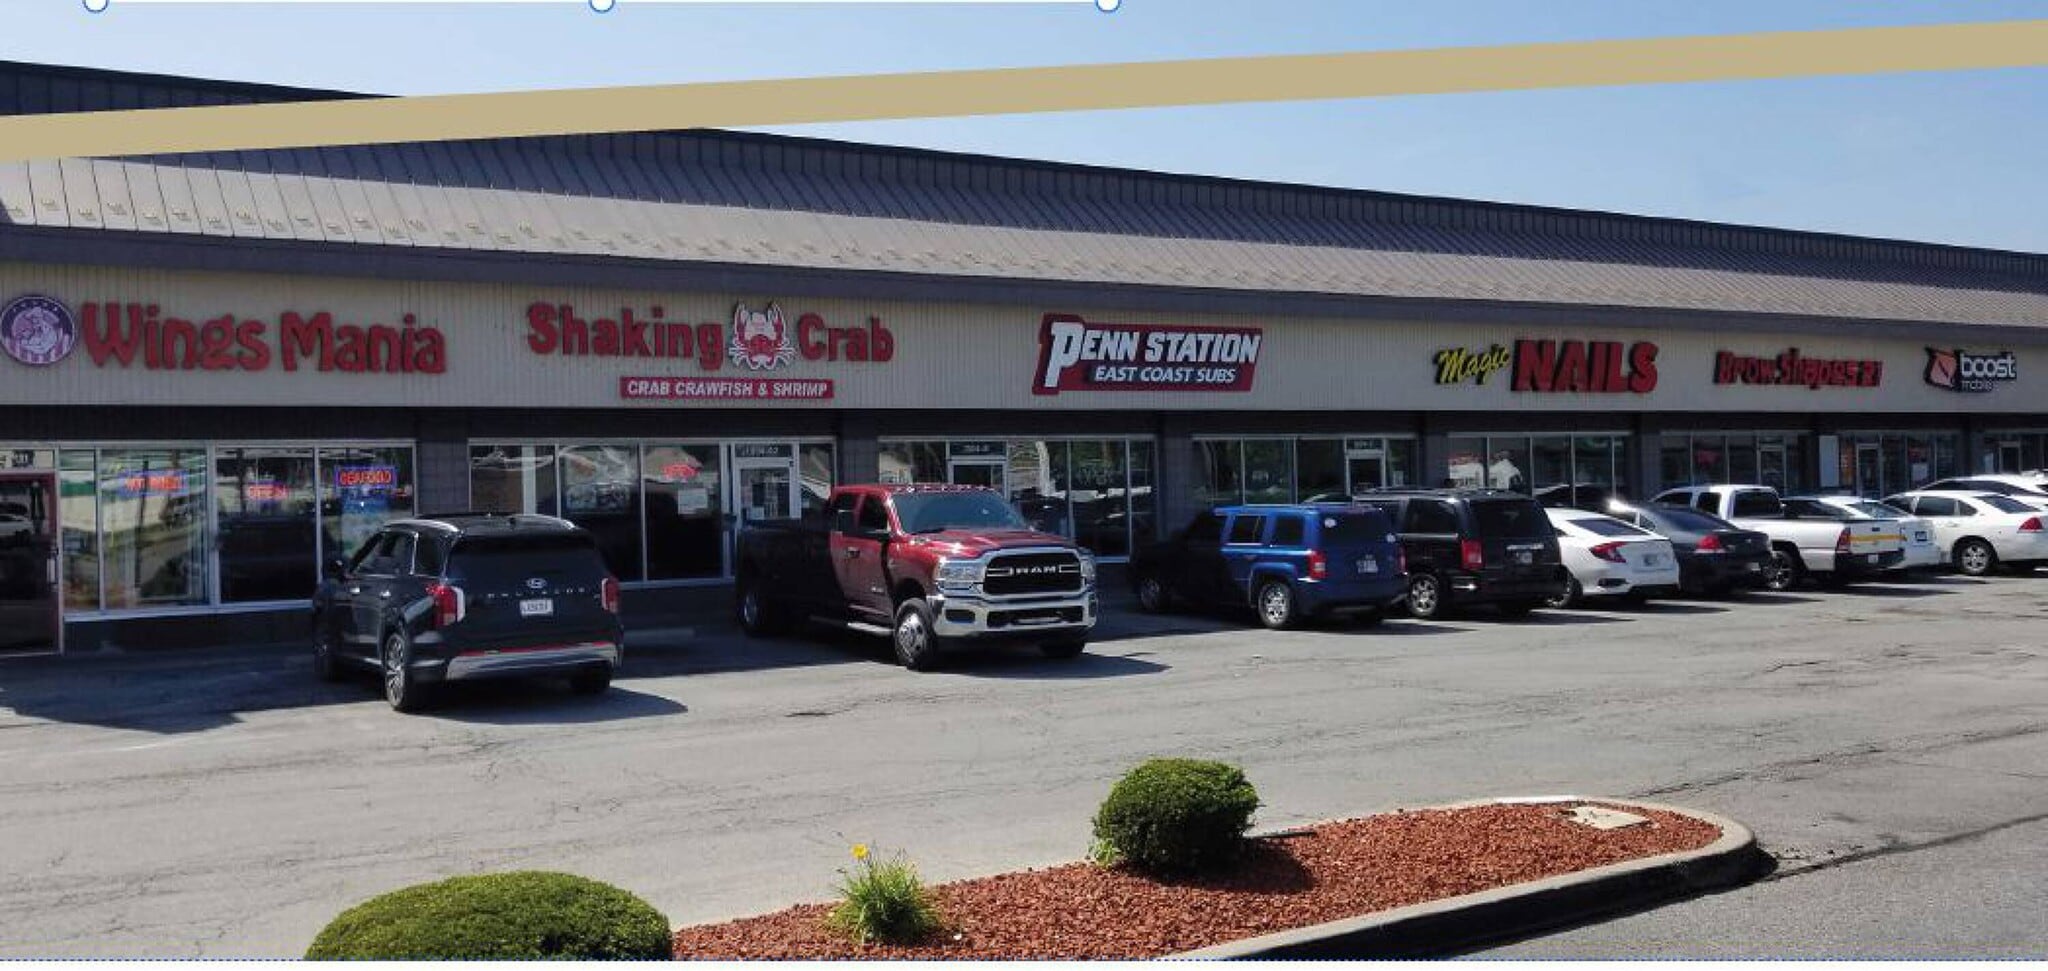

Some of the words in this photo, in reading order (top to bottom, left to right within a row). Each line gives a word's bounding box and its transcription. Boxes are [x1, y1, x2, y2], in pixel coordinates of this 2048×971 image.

[81, 301, 271, 372] Wings
[279, 310, 447, 375] Mania
[526, 301, 724, 371] Shaking
[797, 311, 896, 363] Crab
[1044, 320, 1139, 389] PENN
[1144, 331, 1261, 364] STATION
[1094, 365, 1138, 382] EAST
[1140, 366, 1194, 383] COAST
[1196, 367, 1237, 384] SUBS
[1434, 344, 1511, 386] Magic
[1512, 339, 1660, 393] NAILS
[1961, 353, 2016, 378] boost
[627, 379, 670, 396] CRAB
[674, 380, 753, 397] CRAWFISH
[758, 382, 769, 397] &
[772, 381, 828, 398] SHRIMP
[1015, 565, 1056, 574] RAM
